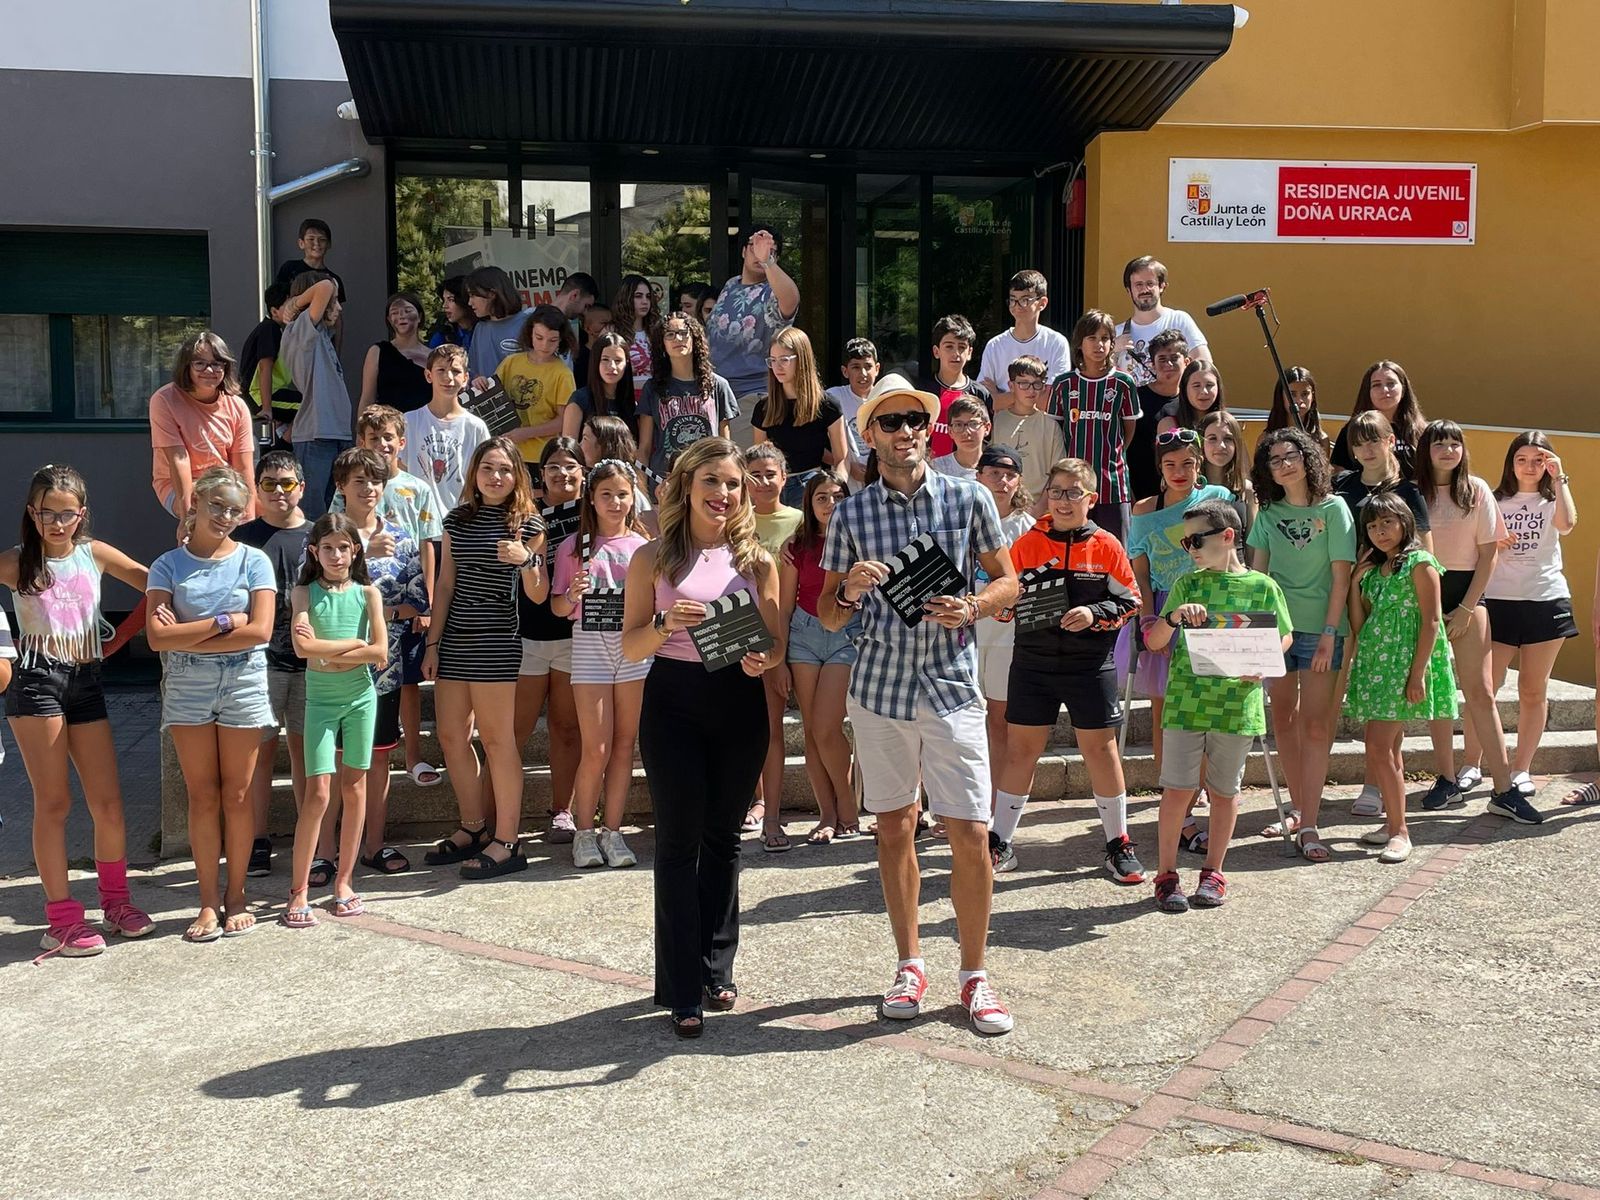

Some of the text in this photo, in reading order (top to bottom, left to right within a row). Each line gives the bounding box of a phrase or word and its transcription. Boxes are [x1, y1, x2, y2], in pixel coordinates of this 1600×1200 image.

[1284, 184, 1466, 201] RESIDENCIA JUVENIL
[1213, 203, 1266, 216] Junta de
[1284, 202, 1413, 221] DOÑA URRACA
[1180, 215, 1266, 230] Castilla y León
[508, 266, 568, 289] INEMA
[1079, 410, 1112, 421] BETANO
[1520, 504, 1528, 512] A
[1505, 521, 1523, 530] ull
[886, 574, 912, 597] PRODUCTION
[892, 585, 913, 603] DIRECTOR
[904, 604, 915, 616] DATE
[940, 576, 953, 588] TAKE
[897, 595, 916, 610] CAMERA
[693, 623, 721, 637] PRODUCTION
[697, 633, 719, 645] DIRECTOR
[701, 642, 720, 653] CAMERA
[706, 635, 761, 661] DATE SCENE TAKE
